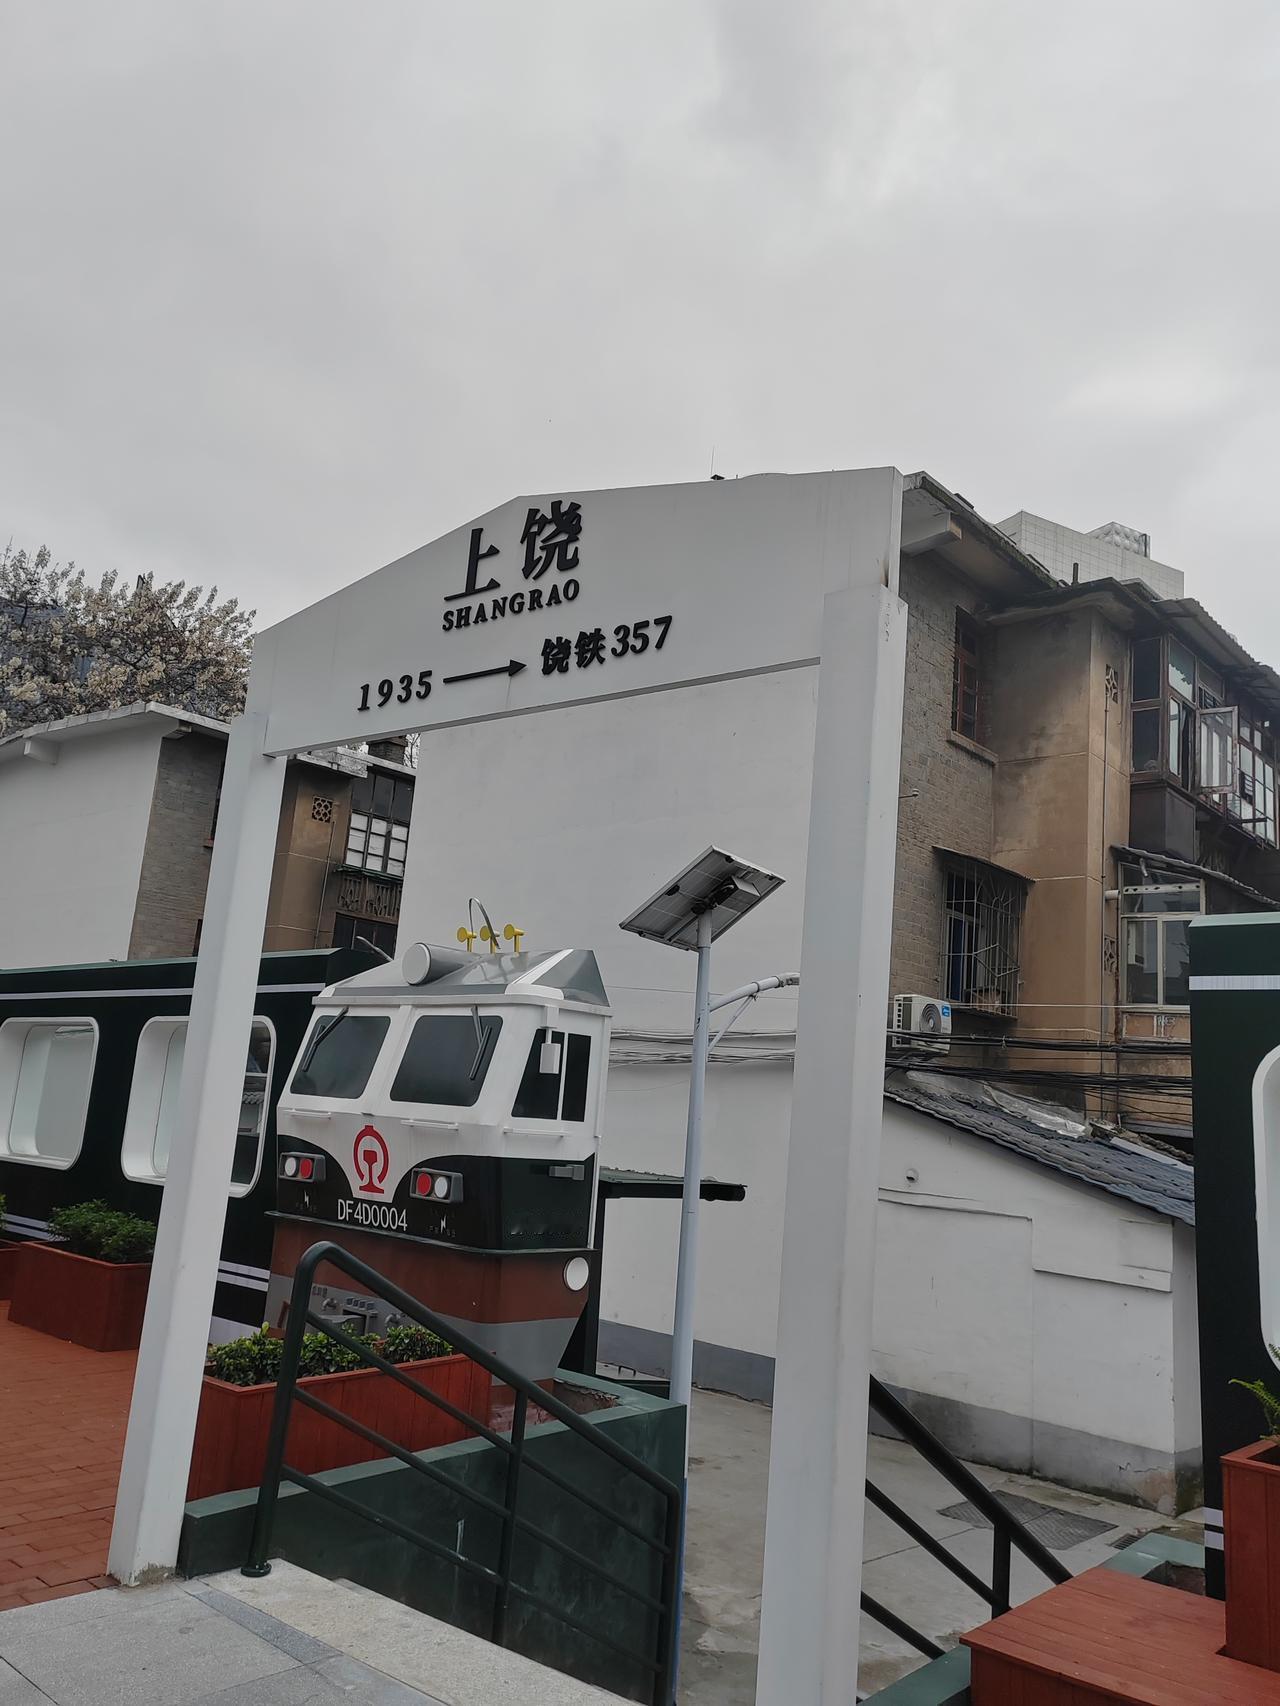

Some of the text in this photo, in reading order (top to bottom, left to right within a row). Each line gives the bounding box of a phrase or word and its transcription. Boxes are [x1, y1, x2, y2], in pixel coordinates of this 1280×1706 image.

[444, 500, 582, 602] 上饶
[442, 578, 580, 632] SHANGRAO
[357, 615, 673, 711] 1935 饶铁357
[337, 1199, 408, 1231] DF4D0004
